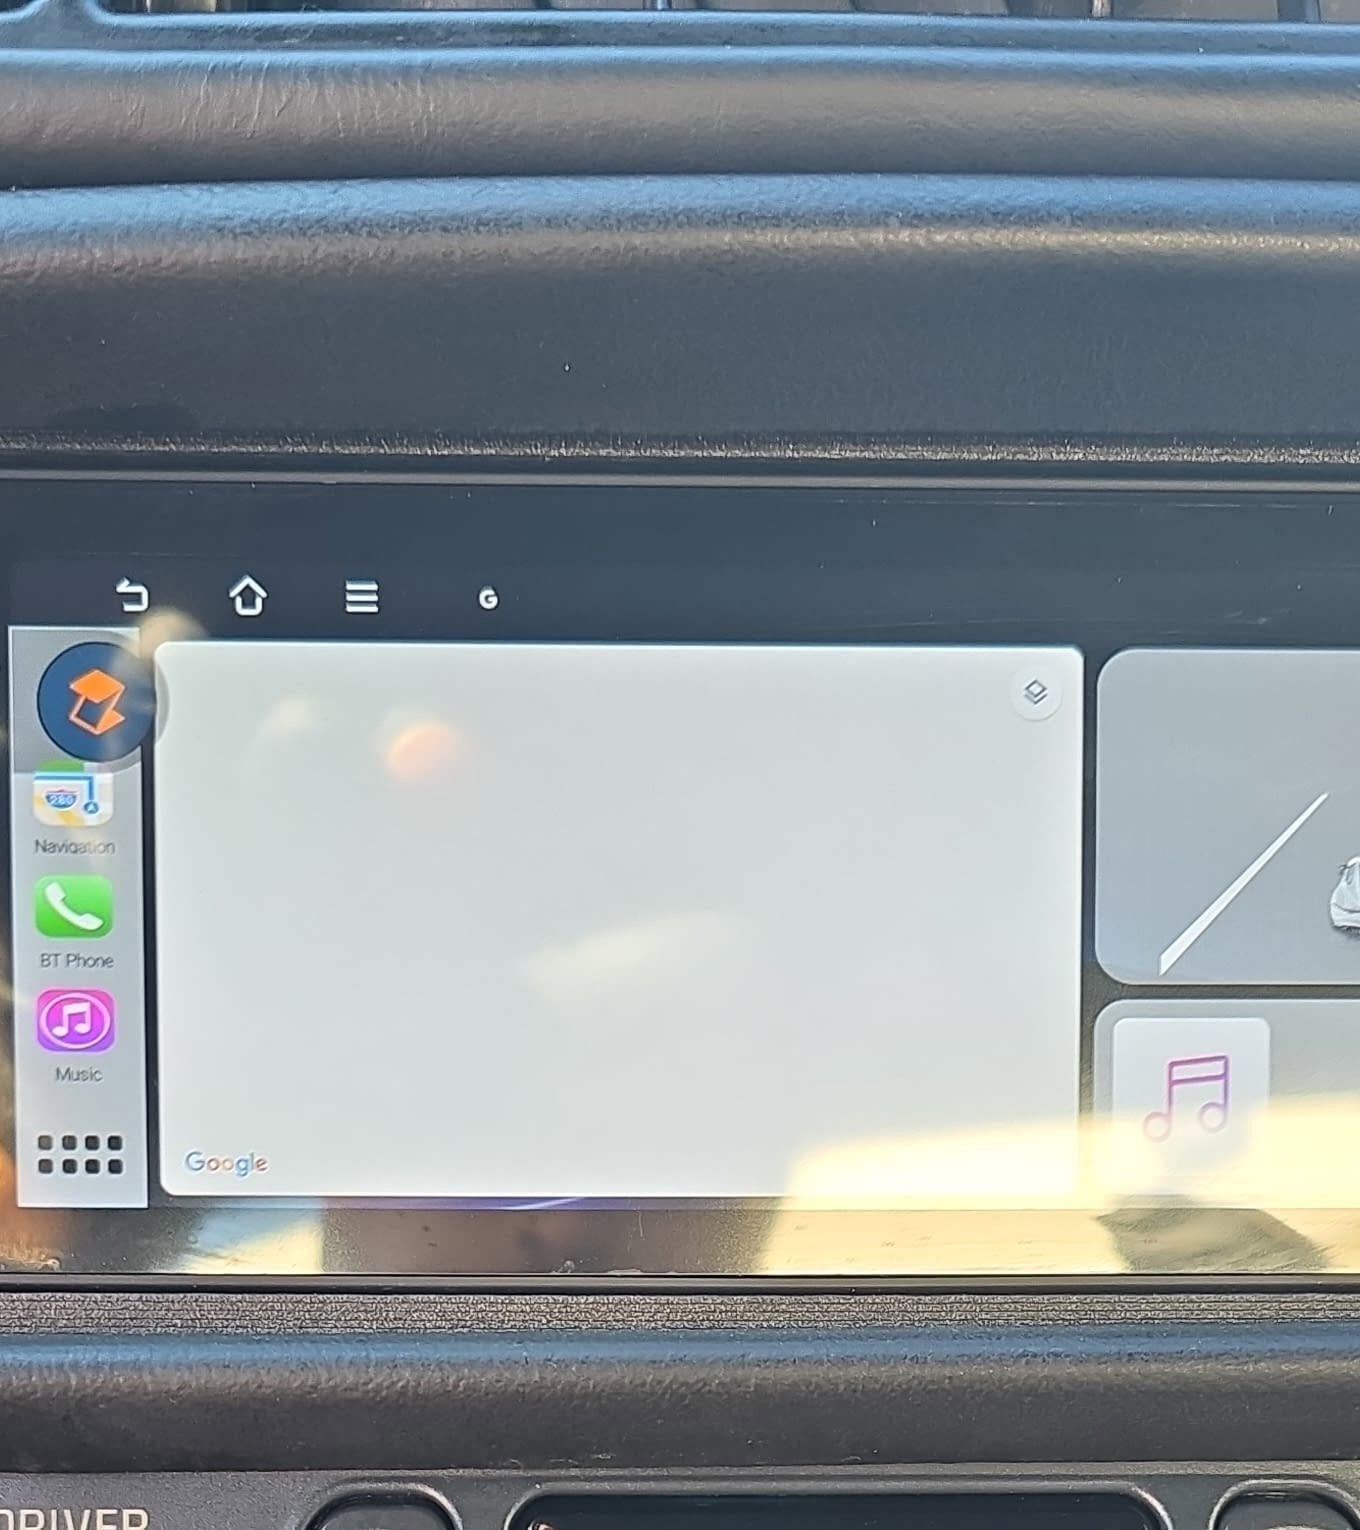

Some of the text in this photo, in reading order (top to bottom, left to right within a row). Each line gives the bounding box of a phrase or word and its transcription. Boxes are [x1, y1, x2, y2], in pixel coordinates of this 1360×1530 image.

[34, 839, 116, 855] Navigation
[39, 952, 115, 969] BT Phone
[55, 1066, 103, 1082] Music
[185, 1151, 268, 1177] Google
